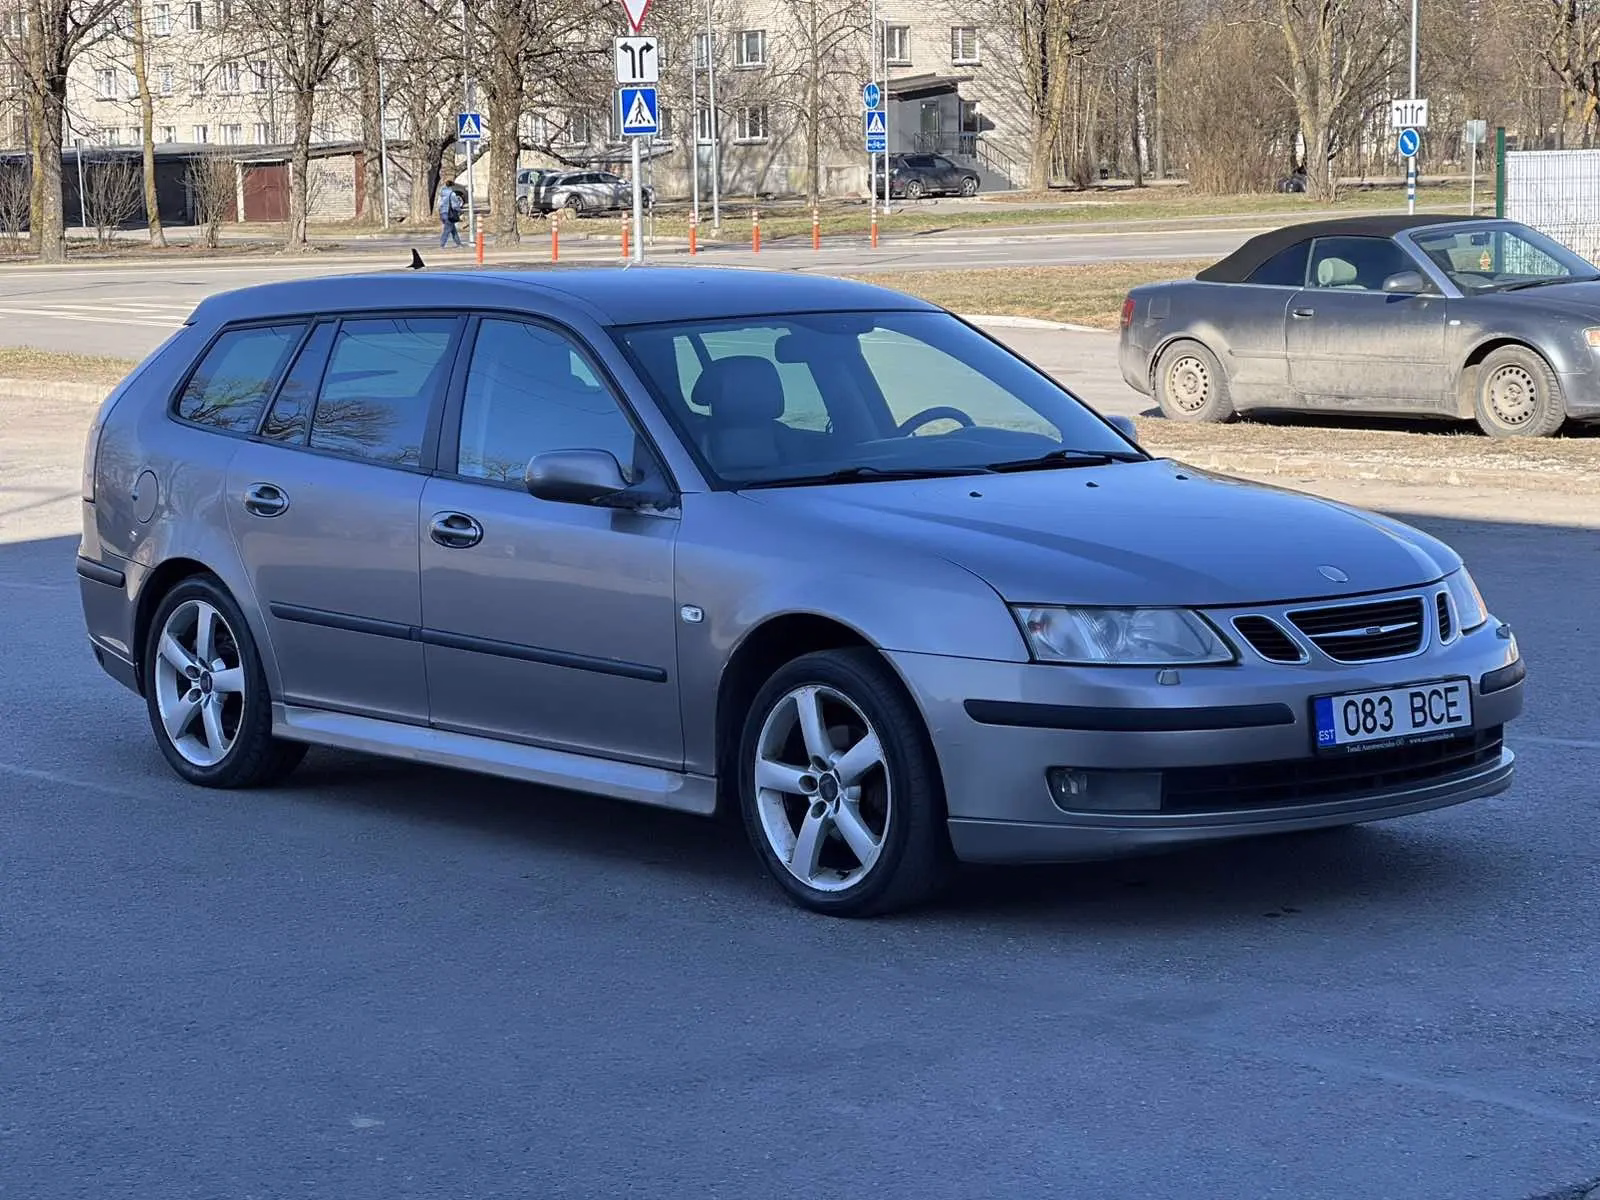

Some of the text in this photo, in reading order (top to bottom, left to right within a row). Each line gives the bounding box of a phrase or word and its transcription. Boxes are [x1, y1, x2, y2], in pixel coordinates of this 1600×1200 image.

[1343, 686, 1463, 736] 083 BCE
[1319, 729, 1335, 741] EST
